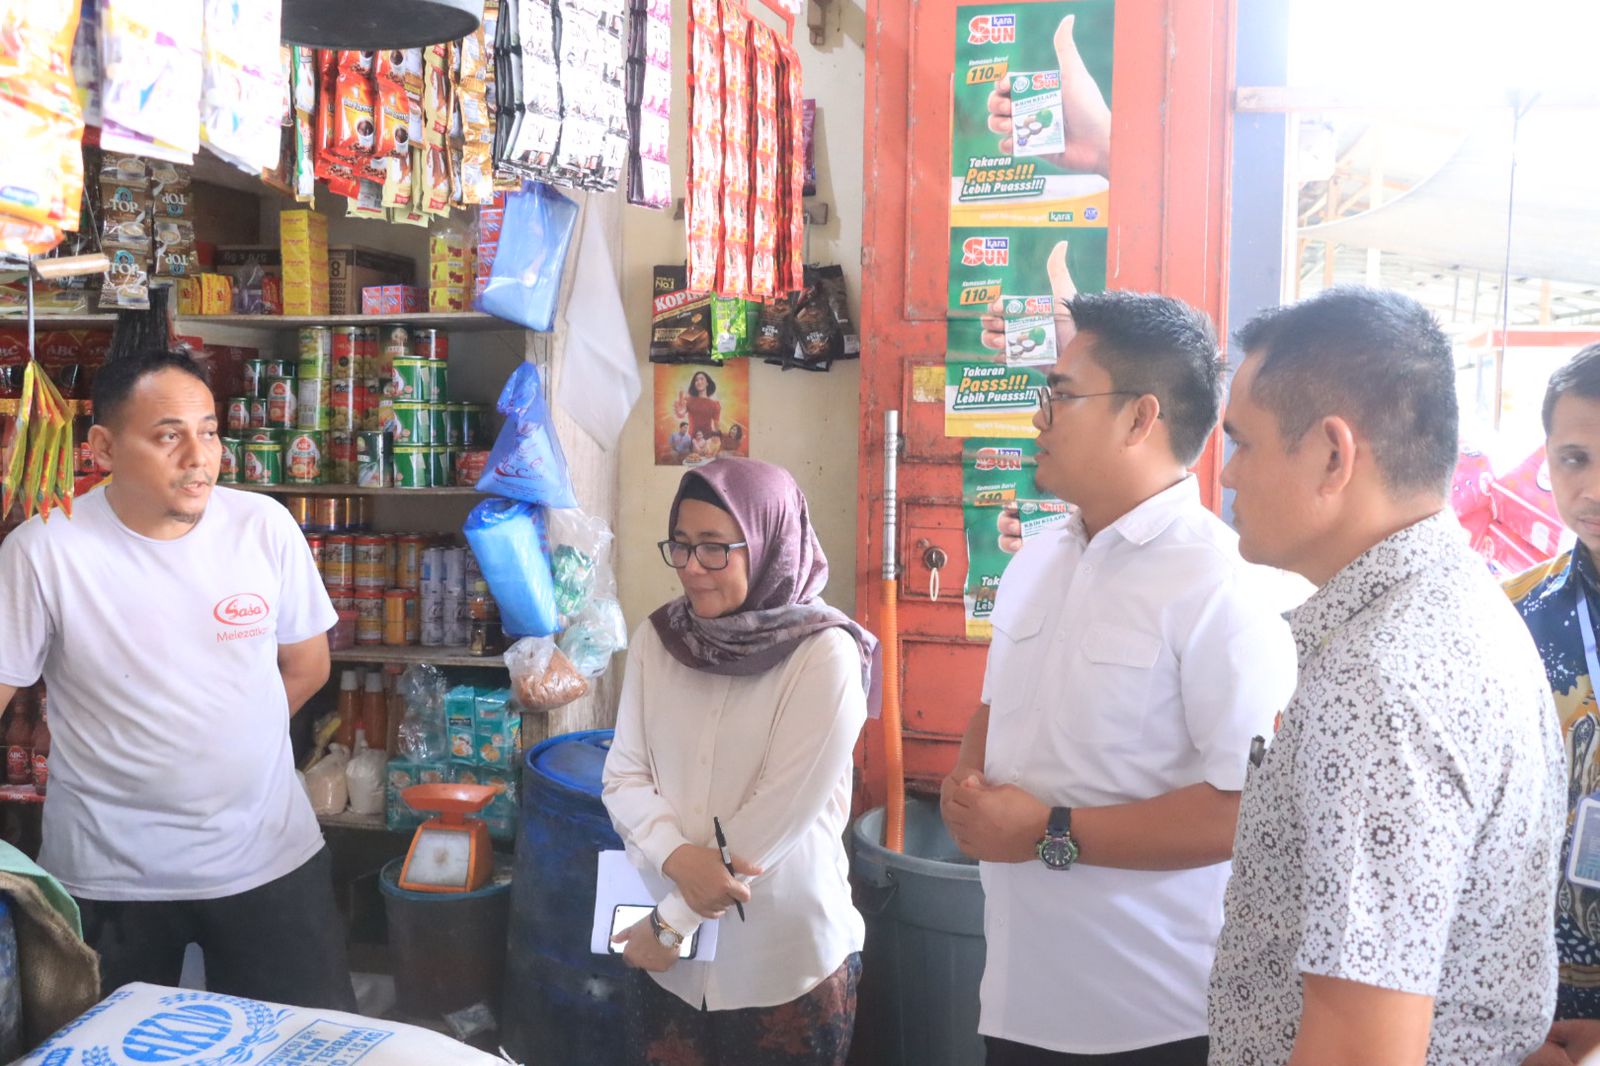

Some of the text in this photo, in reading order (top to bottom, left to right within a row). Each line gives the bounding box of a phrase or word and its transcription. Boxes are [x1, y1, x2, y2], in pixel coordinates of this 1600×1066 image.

[970, 66, 994, 82] 110
[969, 157, 1012, 168] Takaran
[966, 163, 1035, 184] Passs!!!
[962, 178, 1044, 195] Lebih Puasss!!!
[162, 193, 187, 205] TOP
[110, 199, 138, 213] TOP
[1050, 212, 1072, 222] kara
[986, 239, 1007, 249] kara
[165, 254, 189, 265] TOP
[111, 263, 139, 275] TOP
[964, 289, 988, 303] 110
[963, 366, 1005, 377] Takaran
[959, 374, 1029, 393] Passs!!!
[956, 389, 1037, 404] Lebih Puasss!!!
